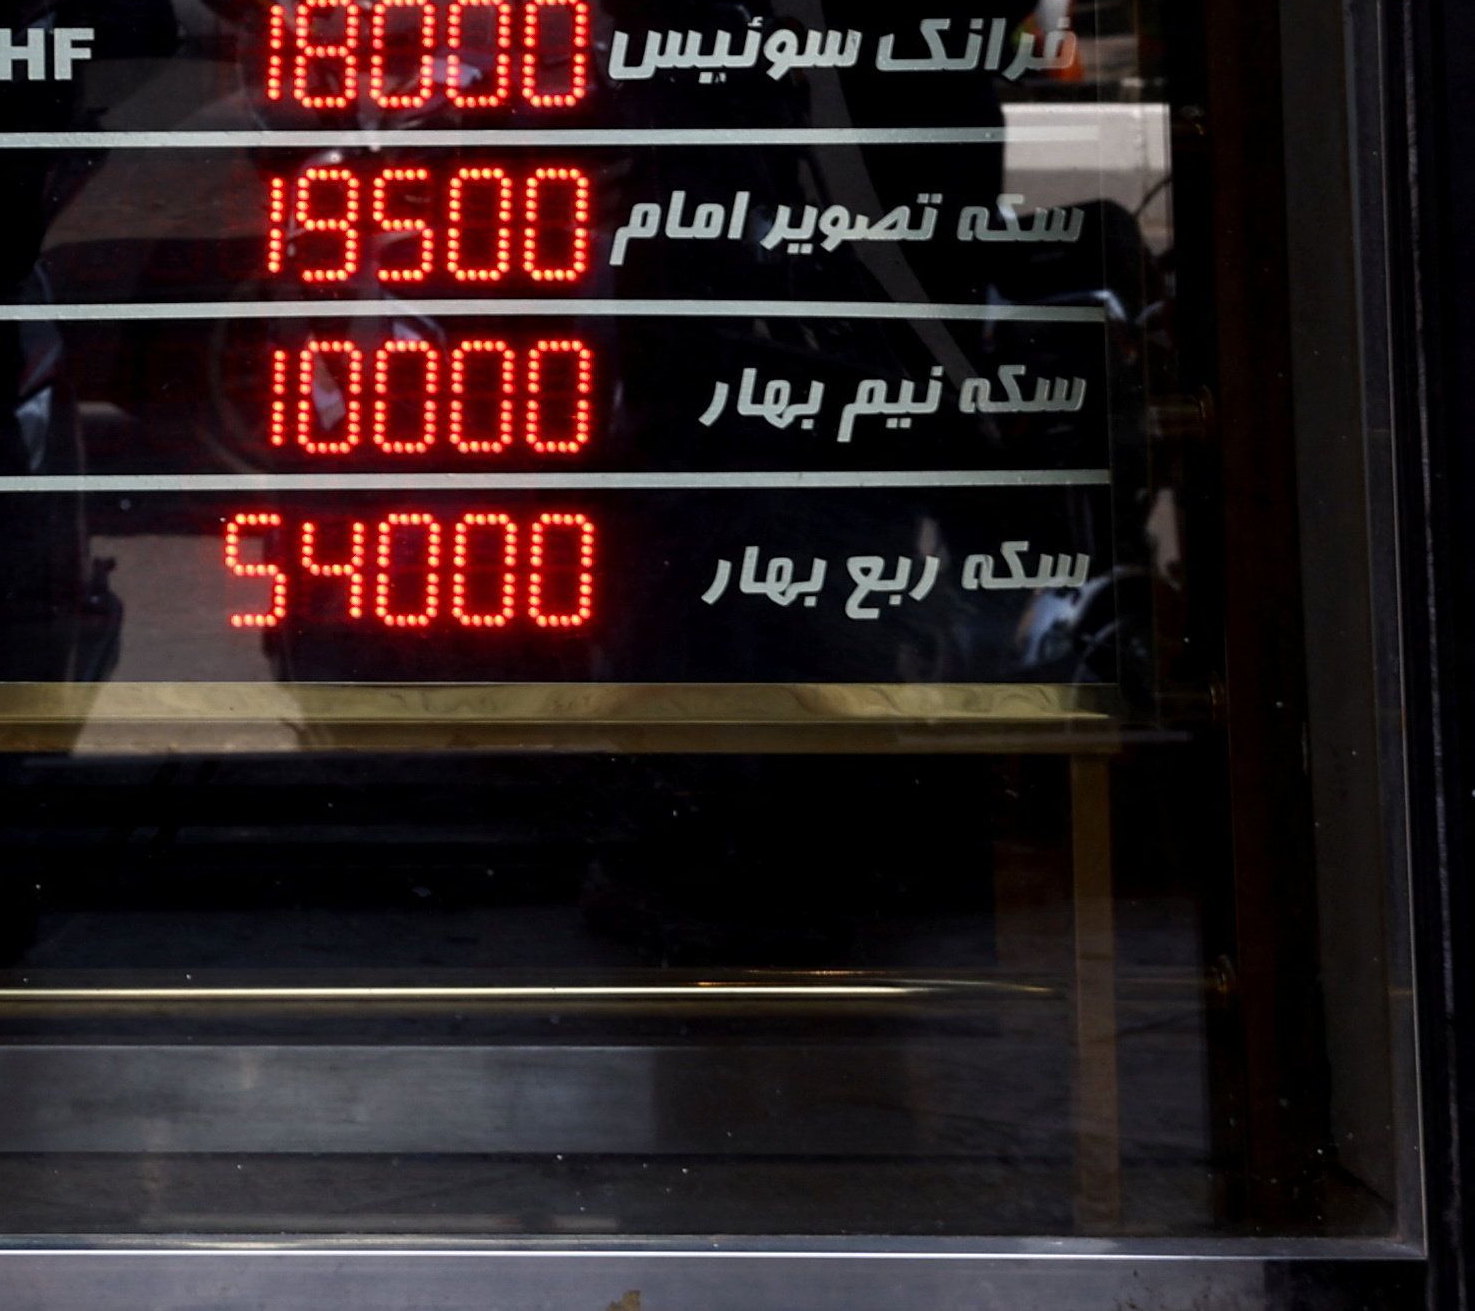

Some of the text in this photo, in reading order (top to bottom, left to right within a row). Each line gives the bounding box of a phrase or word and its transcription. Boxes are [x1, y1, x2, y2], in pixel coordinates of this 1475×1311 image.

[608, 15, 1075, 84] فرانک سوئیس
[266, 165, 591, 284] 19500
[609, 190, 1085, 265] سکه تصویر امام
[270, 338, 593, 456] 10000
[699, 364, 1087, 443] سکه نیم بهار
[223, 511, 597, 629] 54000
[701, 540, 1091, 620] سکه ربع بهار
